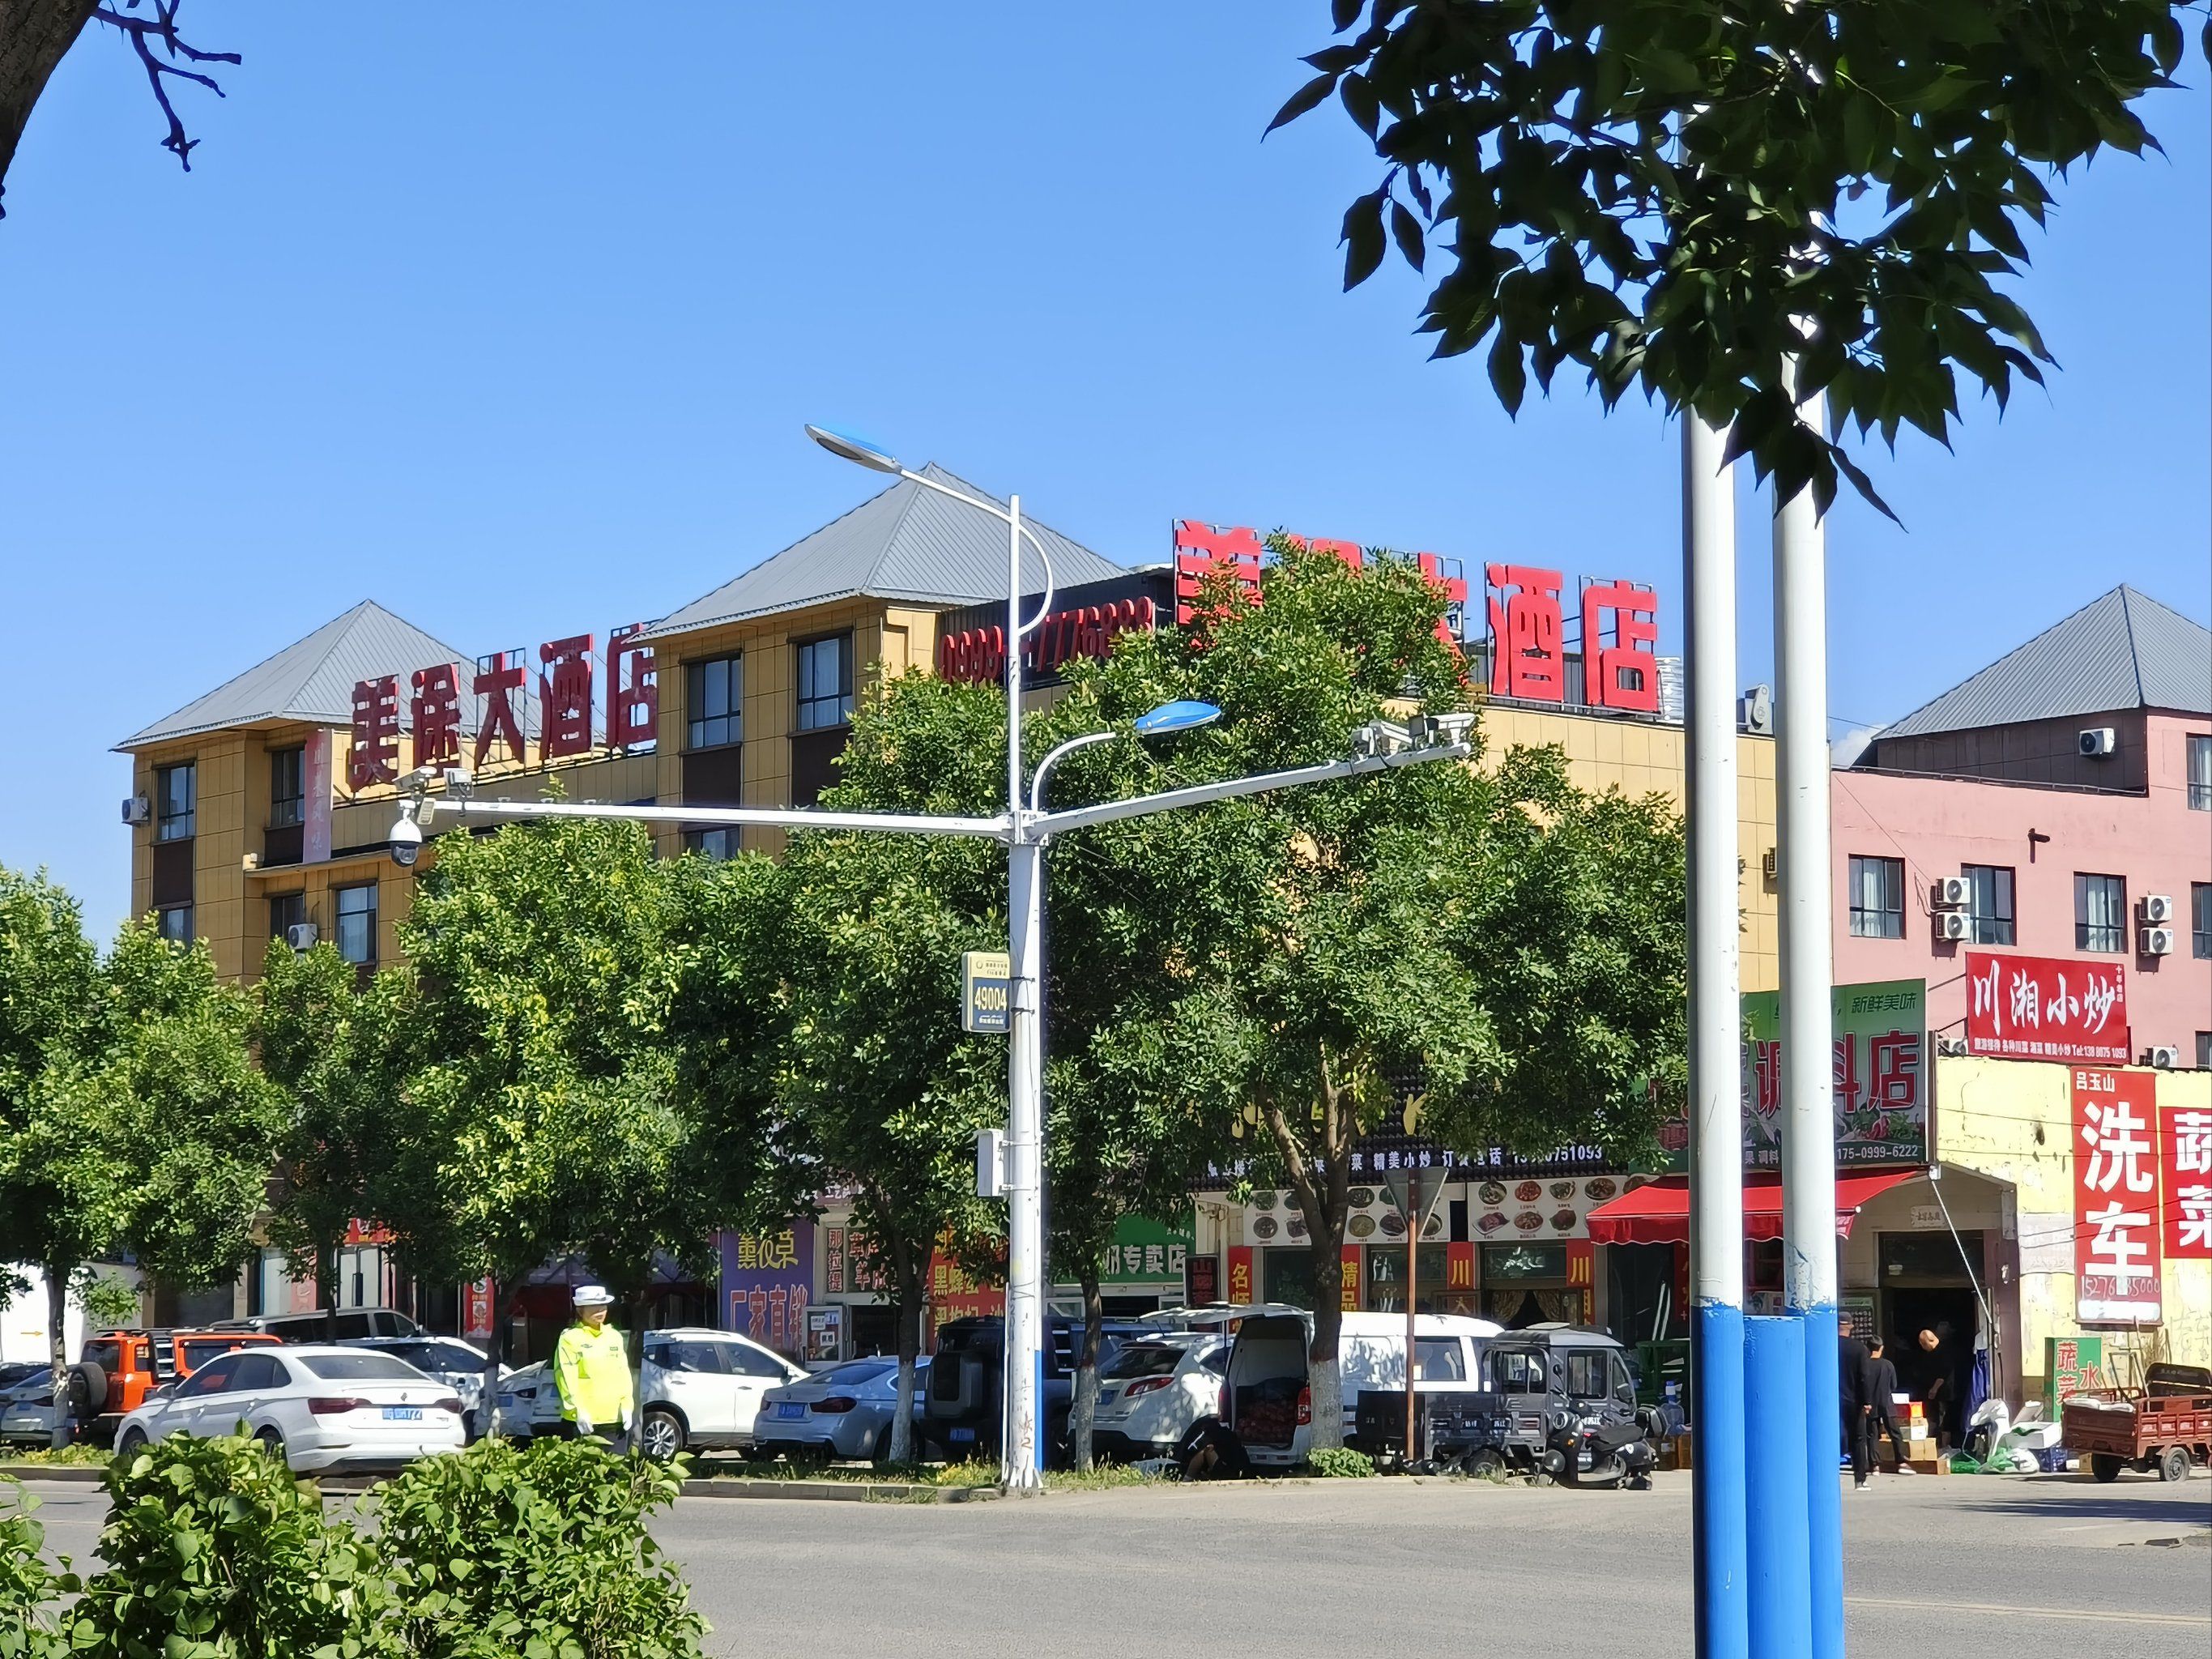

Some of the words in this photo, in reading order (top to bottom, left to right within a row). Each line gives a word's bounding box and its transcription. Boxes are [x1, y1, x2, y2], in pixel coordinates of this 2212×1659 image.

[974, 986, 1008, 1012] 49004
[1851, 992, 1917, 1014] 新鲜美味
[1973, 959, 2116, 1036] 川湘小炒
[2076, 1071, 2116, 1093] 吕玉山
[1373, 1150, 1431, 1171] 精美小炒
[1836, 1145, 1920, 1161] 175-0999-6222
[2081, 1102, 2154, 1296] 洗车
